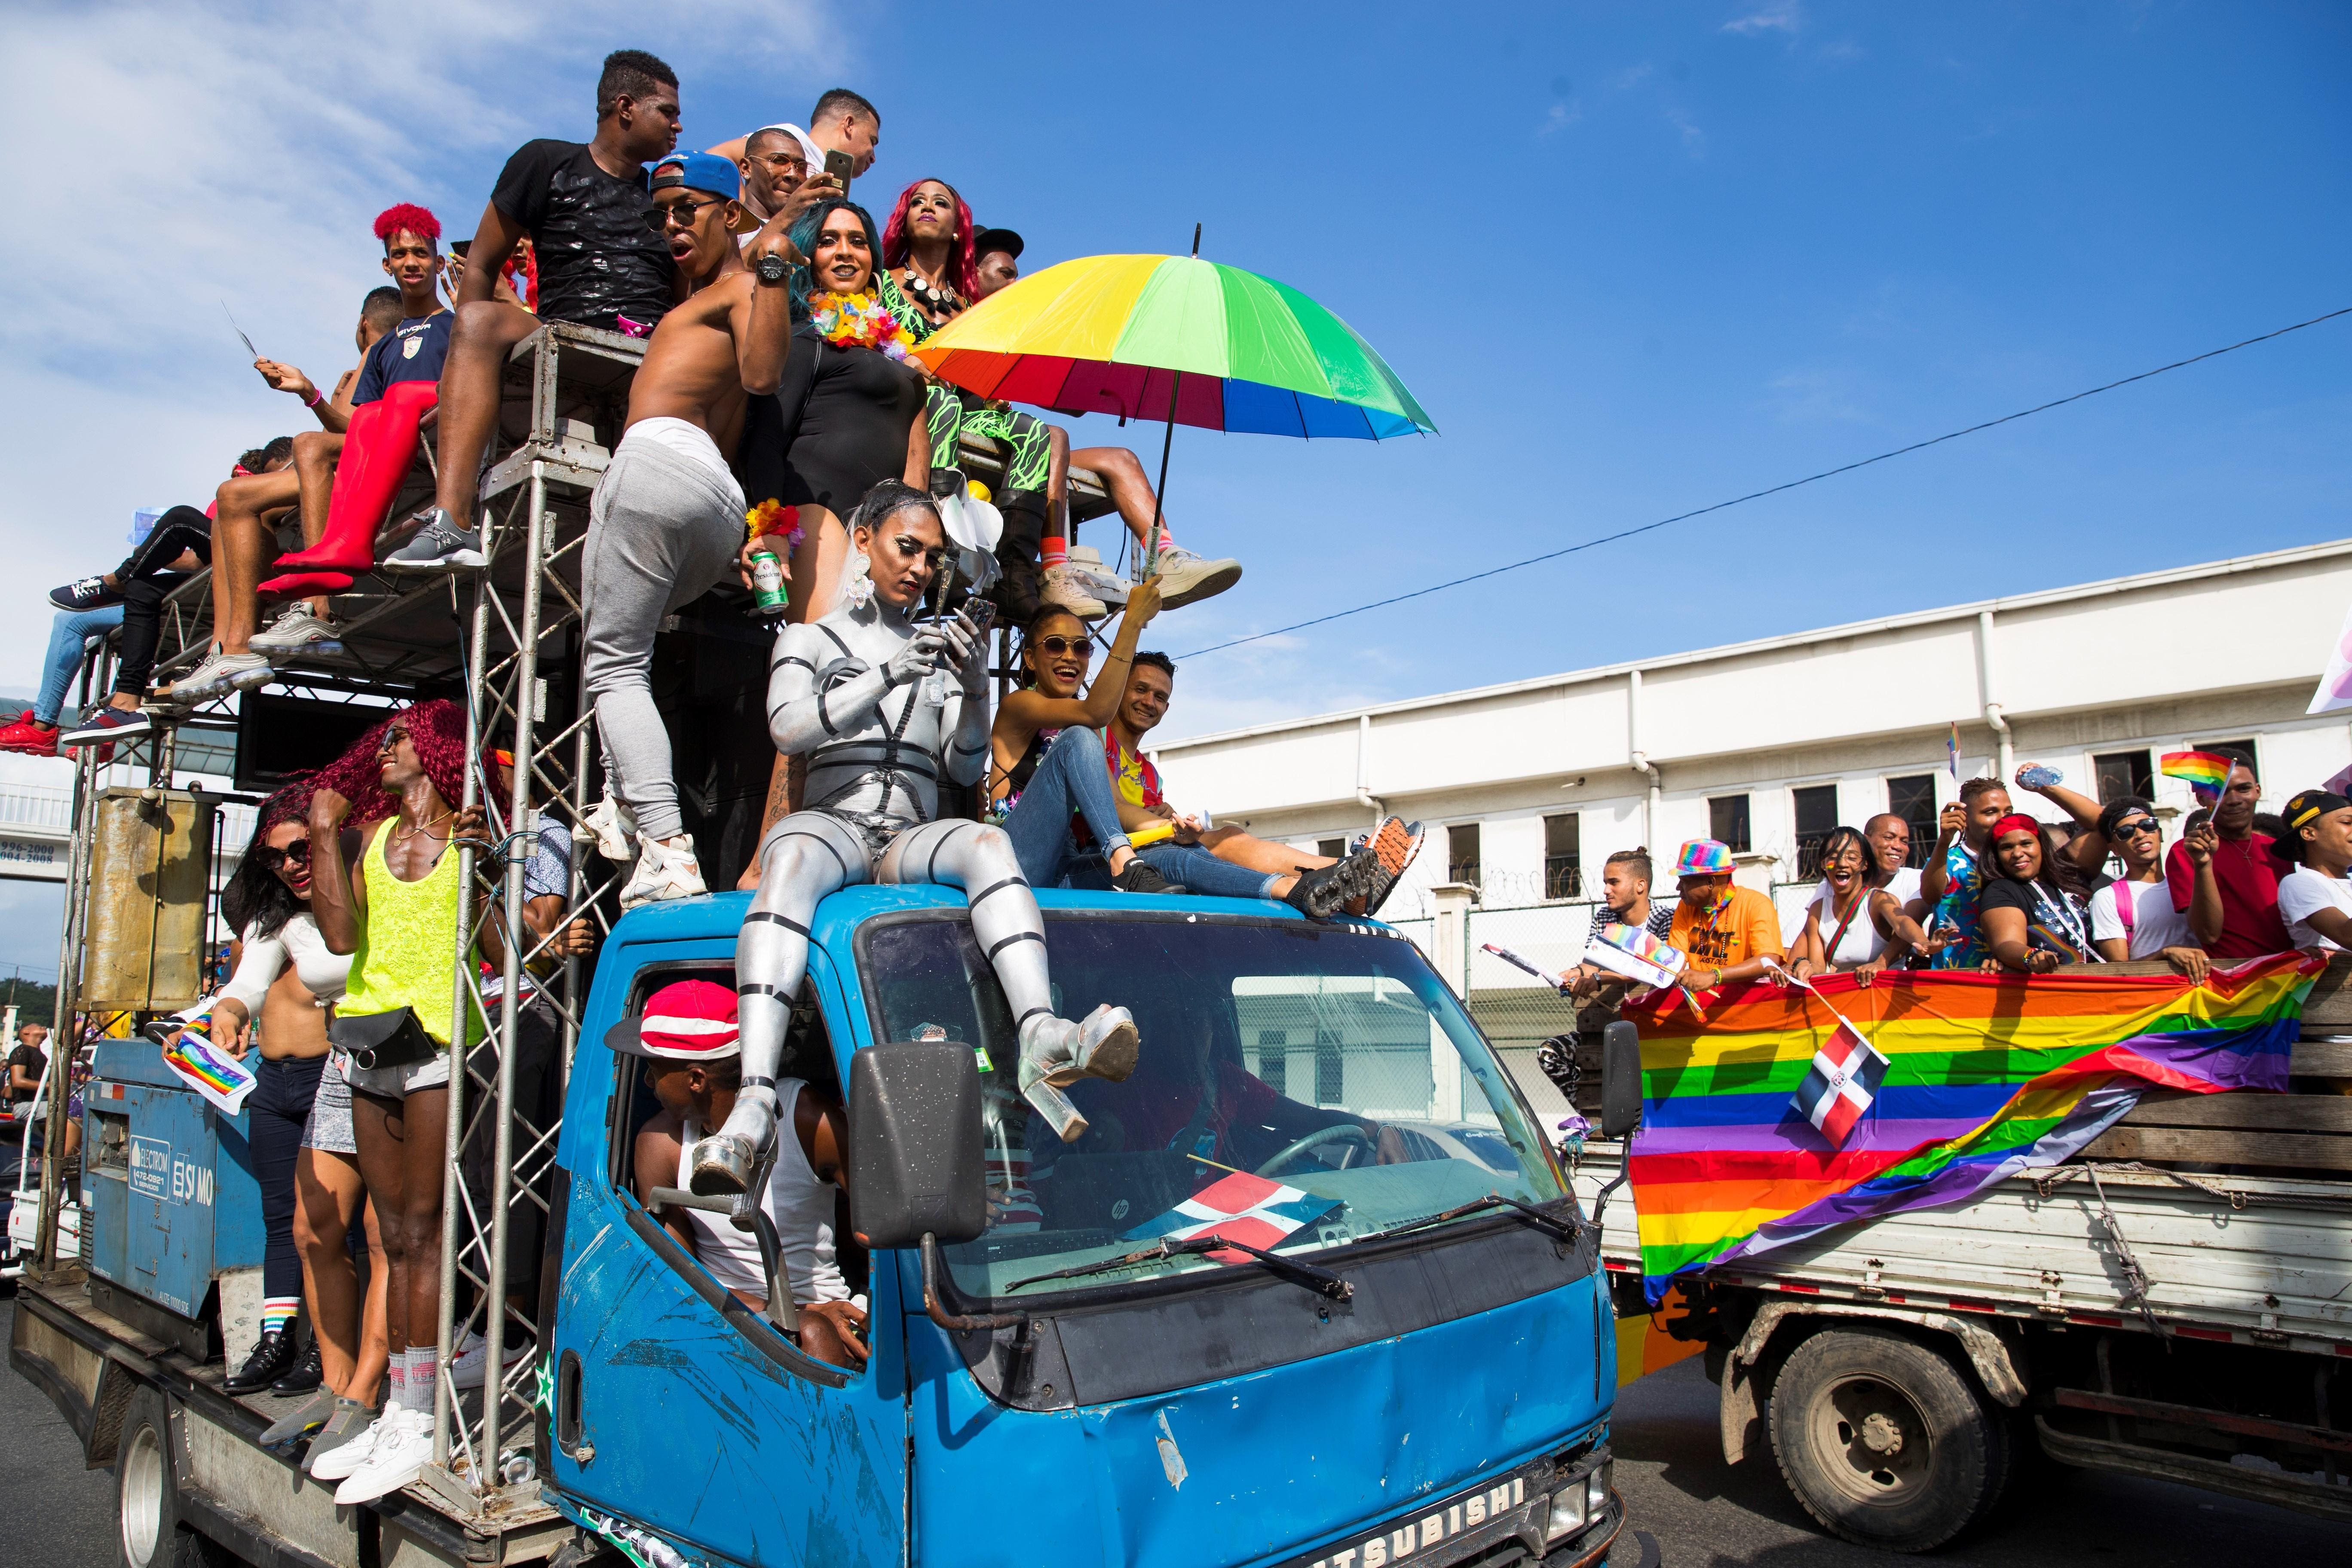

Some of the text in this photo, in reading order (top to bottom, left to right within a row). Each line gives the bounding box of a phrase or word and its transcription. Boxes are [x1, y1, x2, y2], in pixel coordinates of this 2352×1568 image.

[755, 572, 781, 581] Presidente
[136, 1170, 164, 1185] 472-0921
[139, 1181, 159, 1191] SERVICIOS
[1113, 1199, 1128, 1219] hp
[159, 1291, 170, 1305] ALIZE
[170, 1296, 181, 1309] 11000
[1312, 1478, 1524, 1568] TSUBISHI
